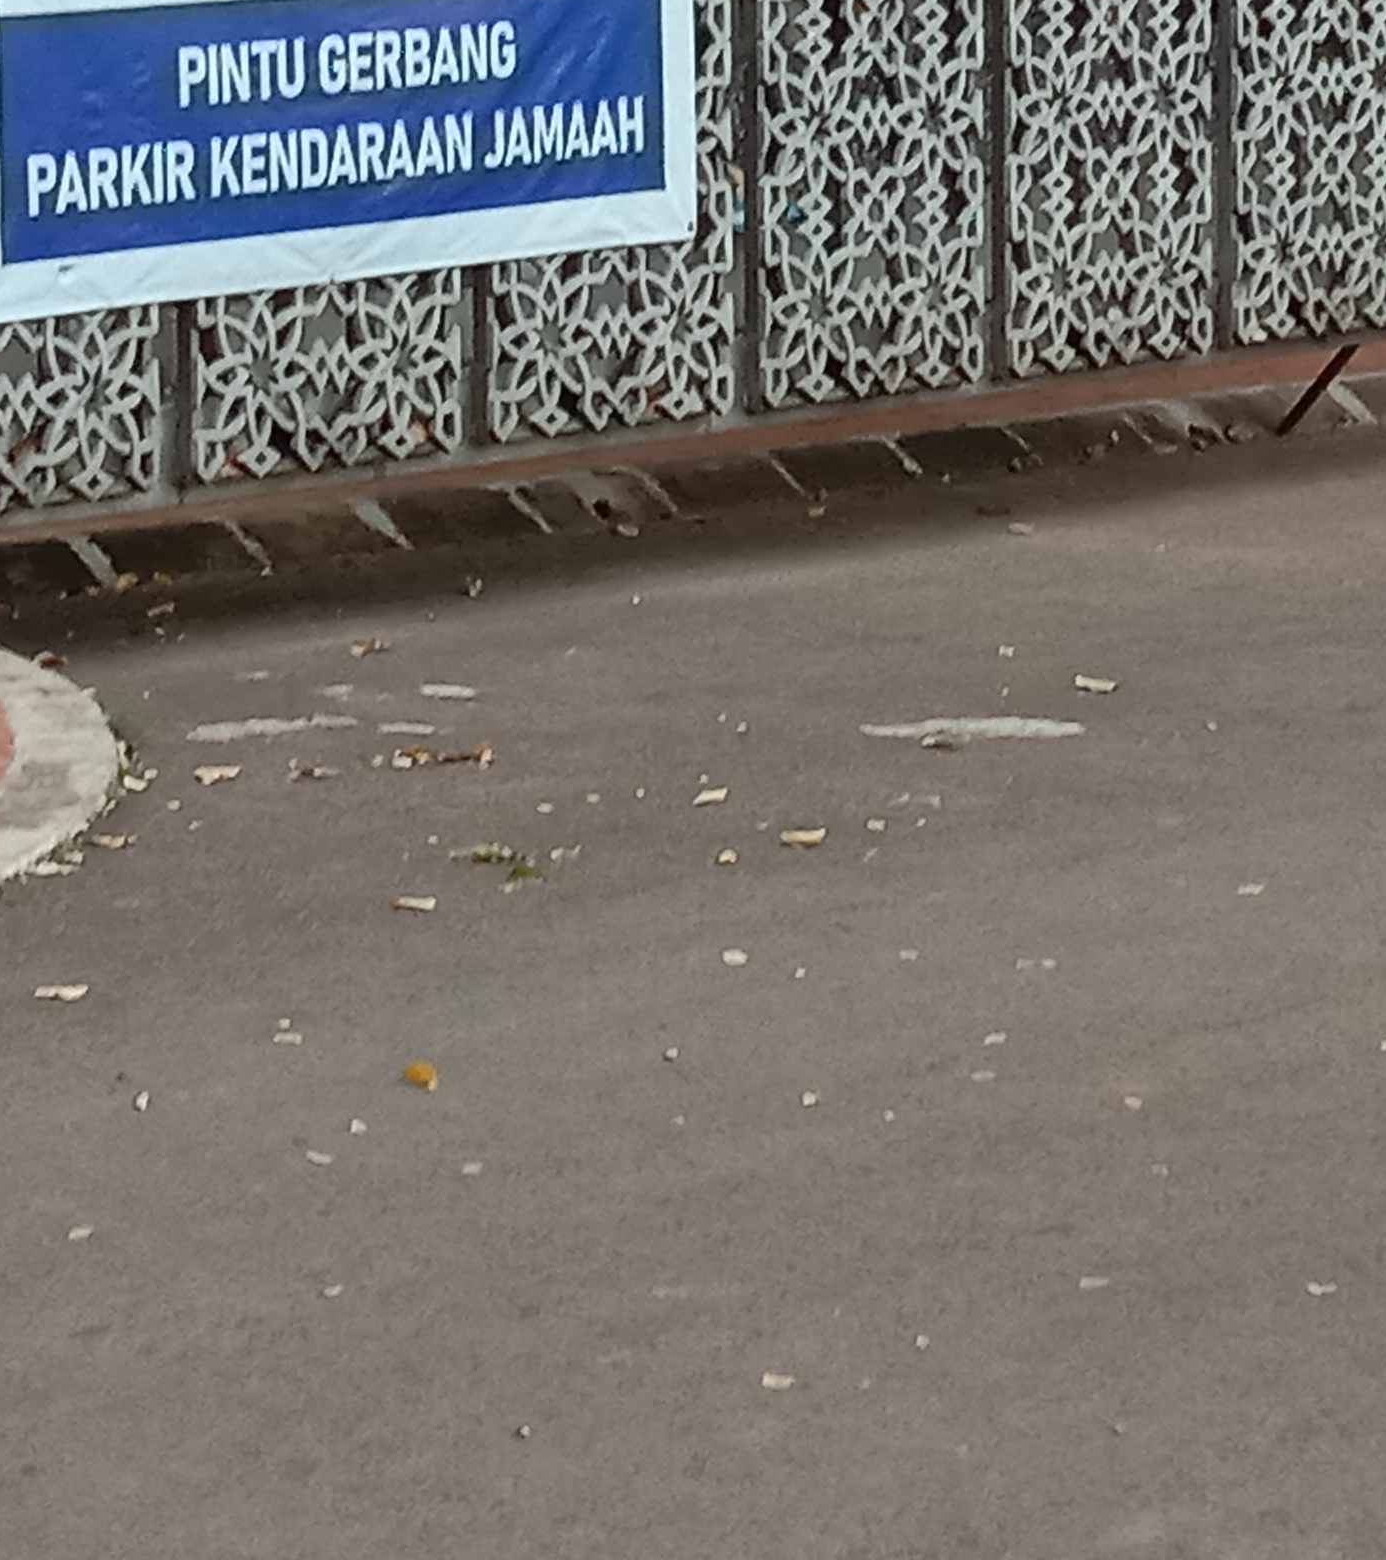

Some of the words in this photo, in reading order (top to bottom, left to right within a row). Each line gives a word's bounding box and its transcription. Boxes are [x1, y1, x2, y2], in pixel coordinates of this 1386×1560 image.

[178, 36, 306, 109] PINTU
[319, 20, 516, 95] GERBANG
[27, 140, 194, 218] PARKIR
[210, 110, 473, 198] KENDARAAN
[485, 95, 645, 168] JAMAAH
